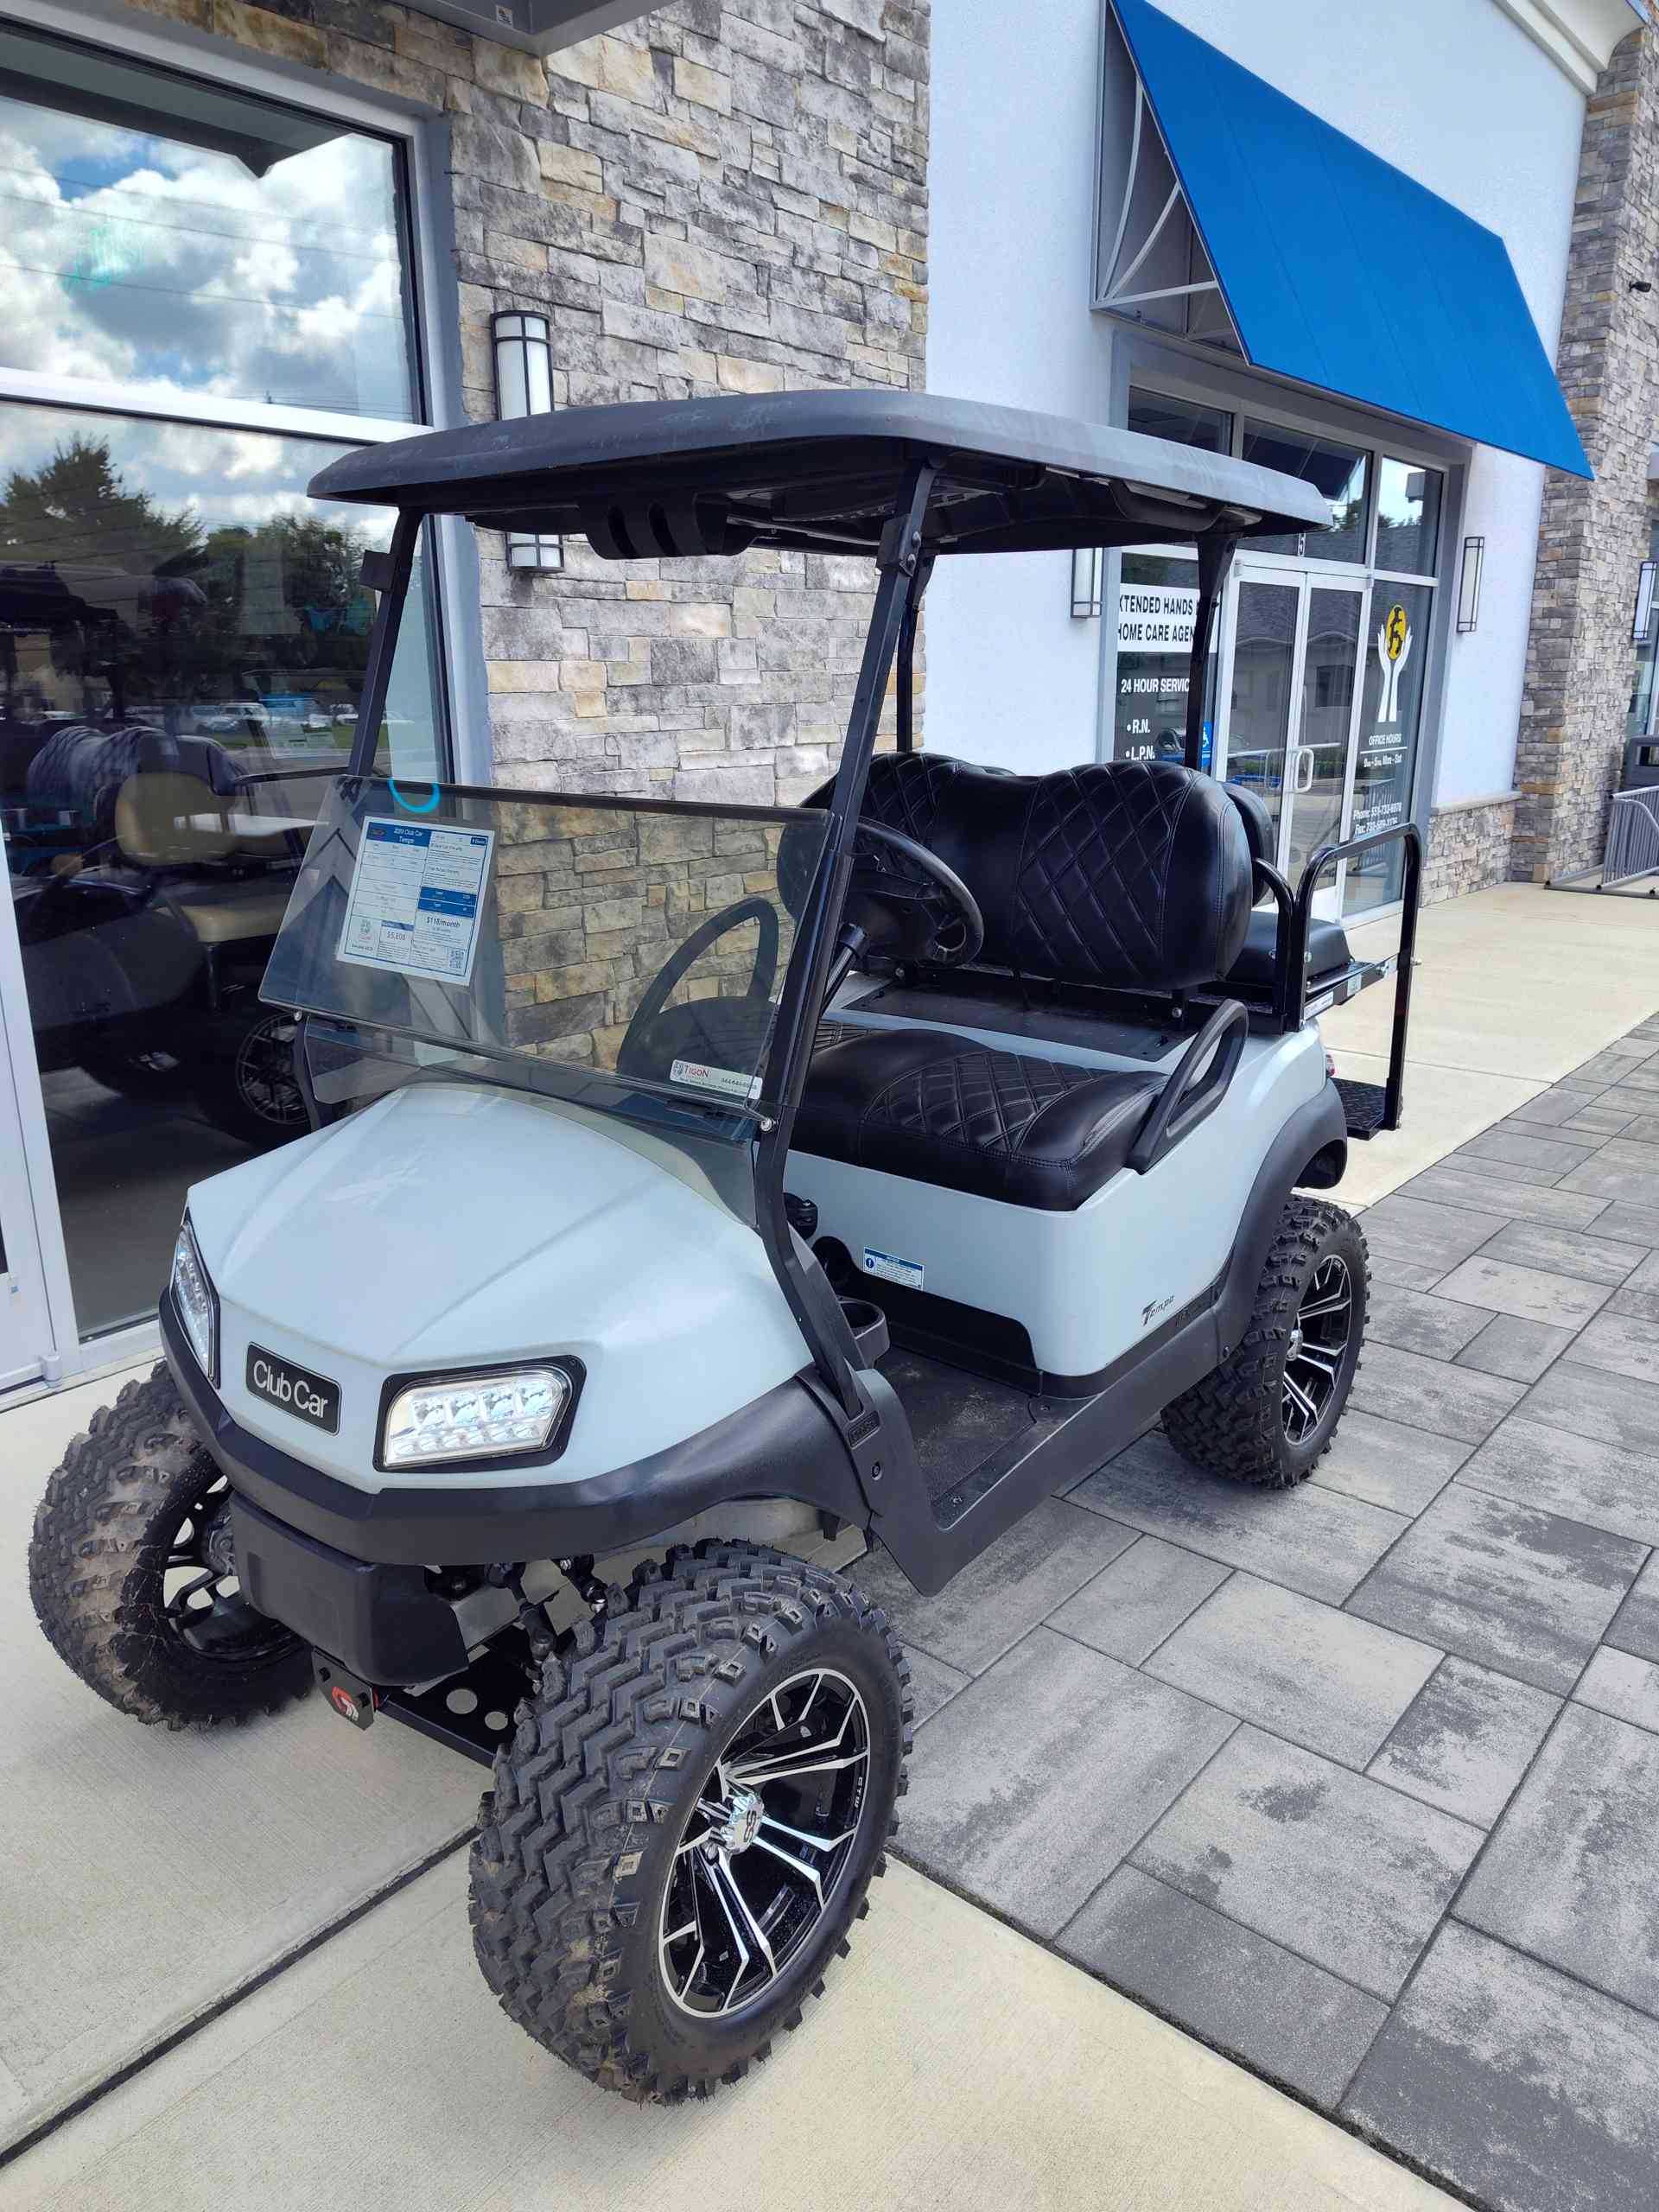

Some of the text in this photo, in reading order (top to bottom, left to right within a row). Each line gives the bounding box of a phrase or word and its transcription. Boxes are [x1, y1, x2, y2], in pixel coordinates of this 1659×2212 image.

[1164, 597, 1193, 616] HANDS
[1146, 624, 1169, 642] CARE
[1121, 678, 1132, 693] 24
[1134, 678, 1159, 693] HOUR
[1369, 733, 1402, 746] OFFICE HOURS
[253, 1360, 328, 1418] Club Car
